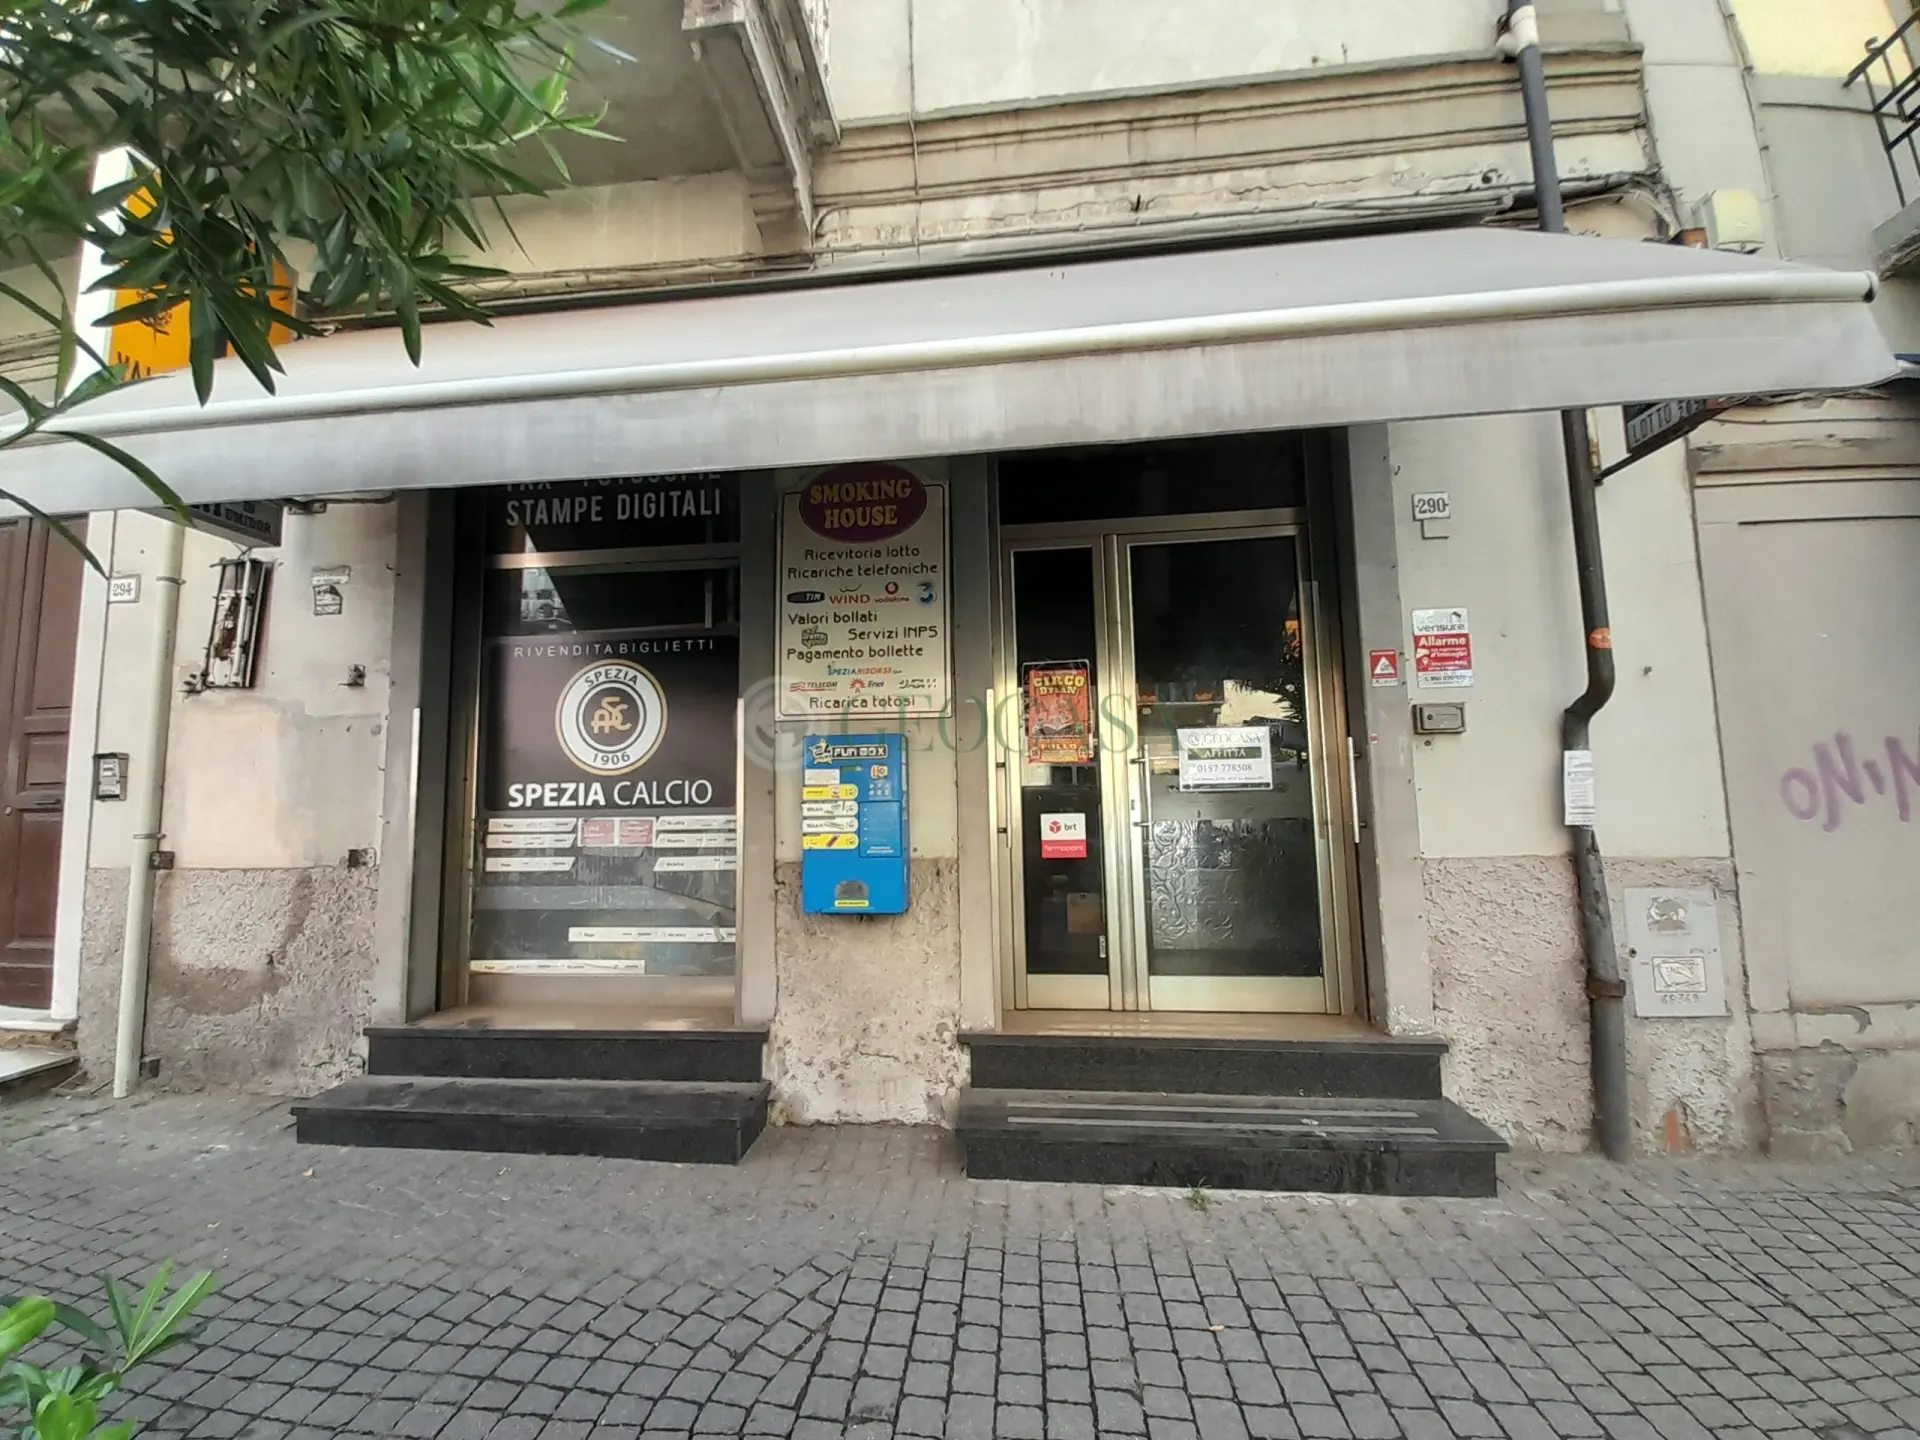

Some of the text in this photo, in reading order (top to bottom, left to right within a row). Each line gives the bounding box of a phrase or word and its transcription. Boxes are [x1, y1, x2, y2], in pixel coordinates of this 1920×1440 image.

[1632, 404, 1673, 443] LOTTO
[811, 479, 912, 505] SMOKING
[506, 488, 721, 527] STAMPE DIGITALI
[824, 505, 898, 529] HOUSE
[804, 544, 921, 561] Ricevitoria lotto
[788, 561, 939, 579] Ricariche telefoniche
[112, 581, 133, 596] 294
[805, 593, 821, 601] TIM
[829, 593, 870, 605] WIND
[788, 610, 878, 625] Valori bollati
[848, 625, 938, 641] Servizi INPS
[514, 639, 714, 658] RIVENDITA BIGLIETTI
[1419, 636, 1467, 647] Allarme
[787, 644, 924, 664] Pagamento bollette
[584, 667, 639, 689] SPEZIA
[1033, 674, 1085, 688] CIRCO
[1039, 686, 1078, 696] DYLAN
[809, 693, 915, 709] Ricarica totosi
[592, 751, 631, 766] 1906
[1197, 763, 1219, 773] 0187
[508, 780, 713, 808] SPEZIA CALCIO
[1063, 822, 1078, 832] brt
